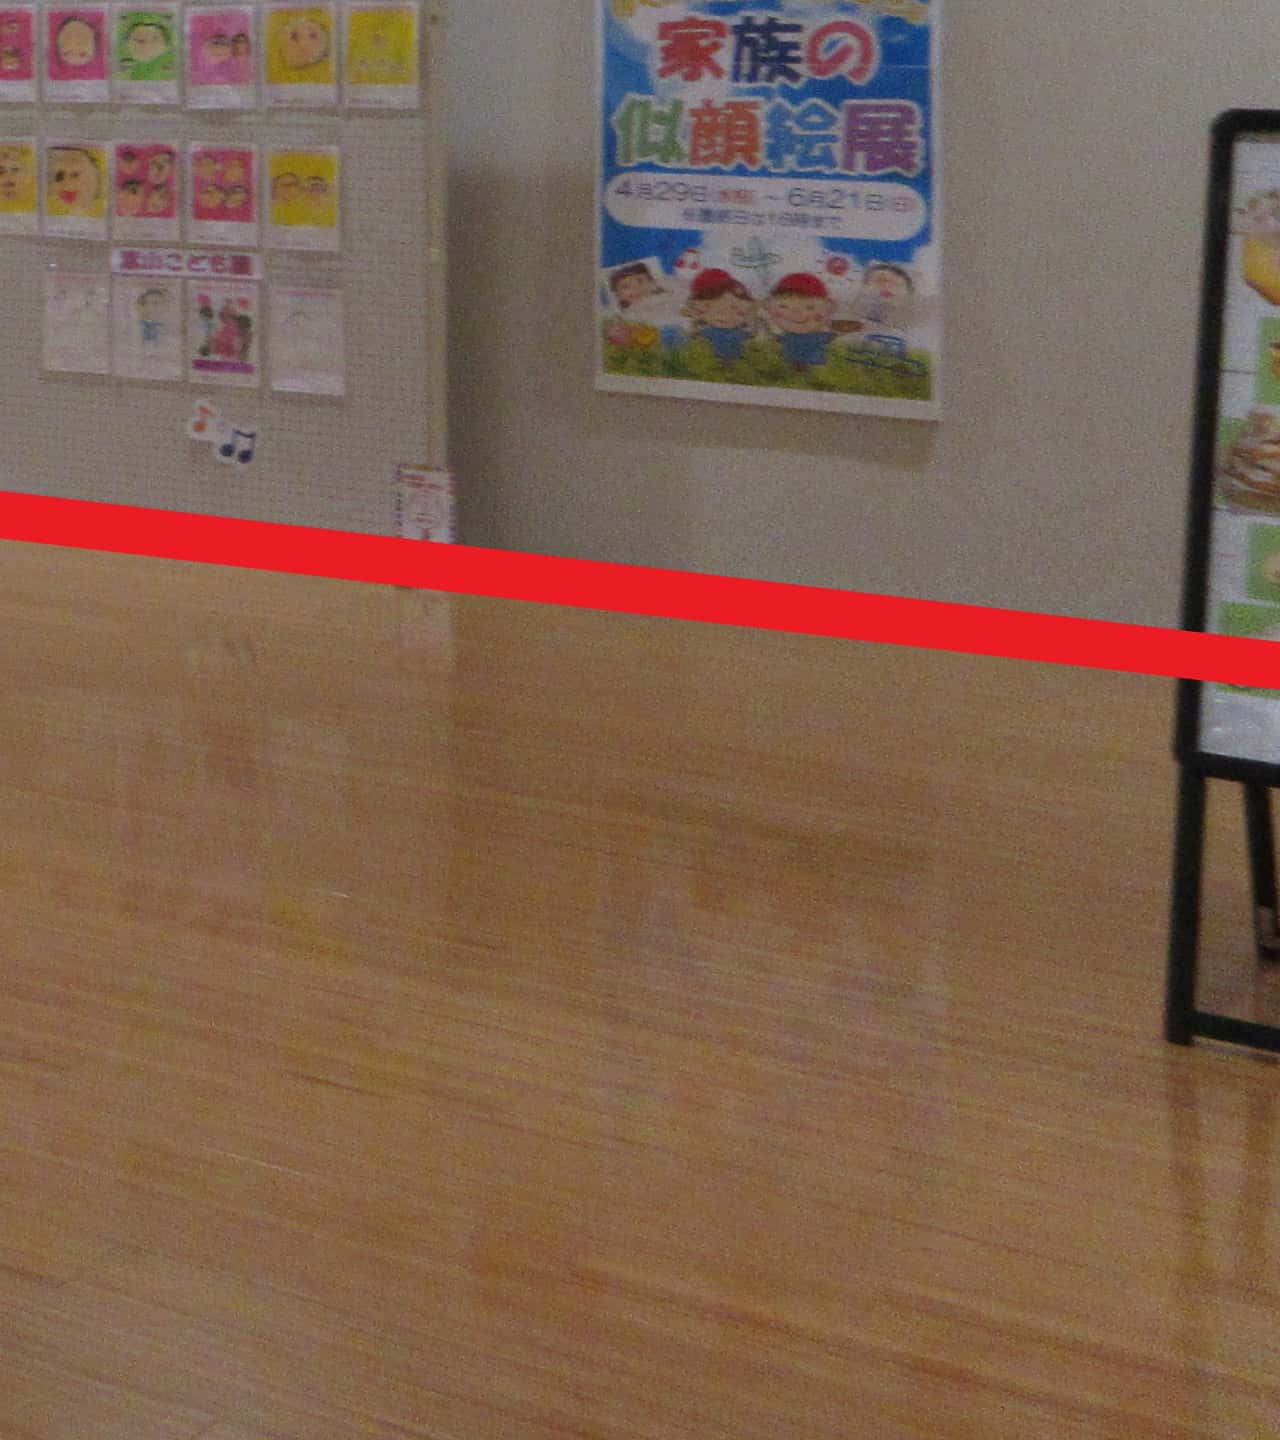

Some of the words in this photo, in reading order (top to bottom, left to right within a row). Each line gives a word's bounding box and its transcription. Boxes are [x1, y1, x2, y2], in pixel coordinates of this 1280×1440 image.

[656, 16, 877, 83] 家族の
[615, 98, 920, 171] 似顔絵展
